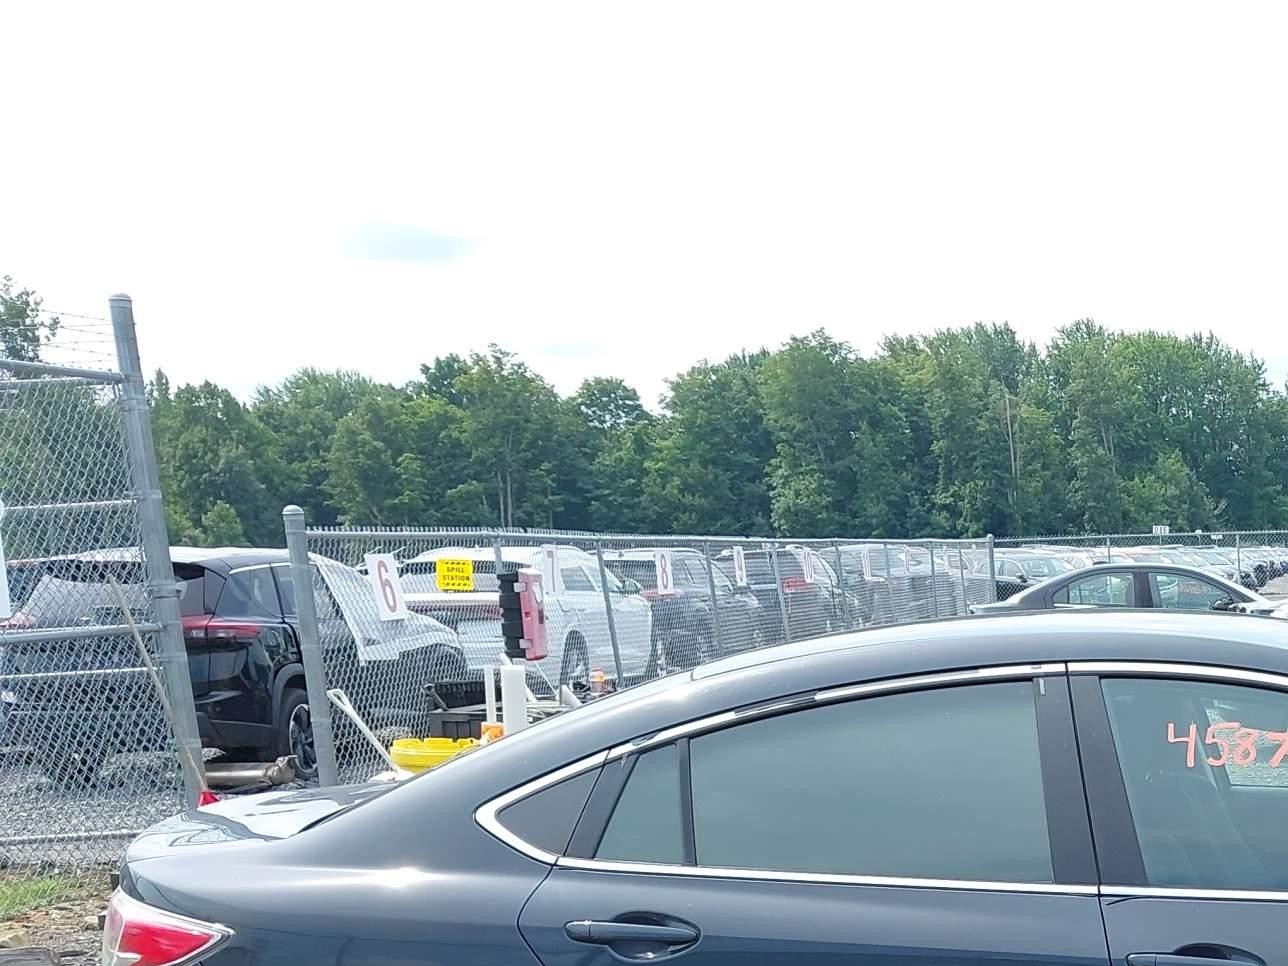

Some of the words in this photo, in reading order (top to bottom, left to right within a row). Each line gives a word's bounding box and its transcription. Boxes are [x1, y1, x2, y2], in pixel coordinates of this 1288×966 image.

[377, 559, 398, 614] 6
[546, 550, 556, 593] 7
[659, 553, 669, 590] 8
